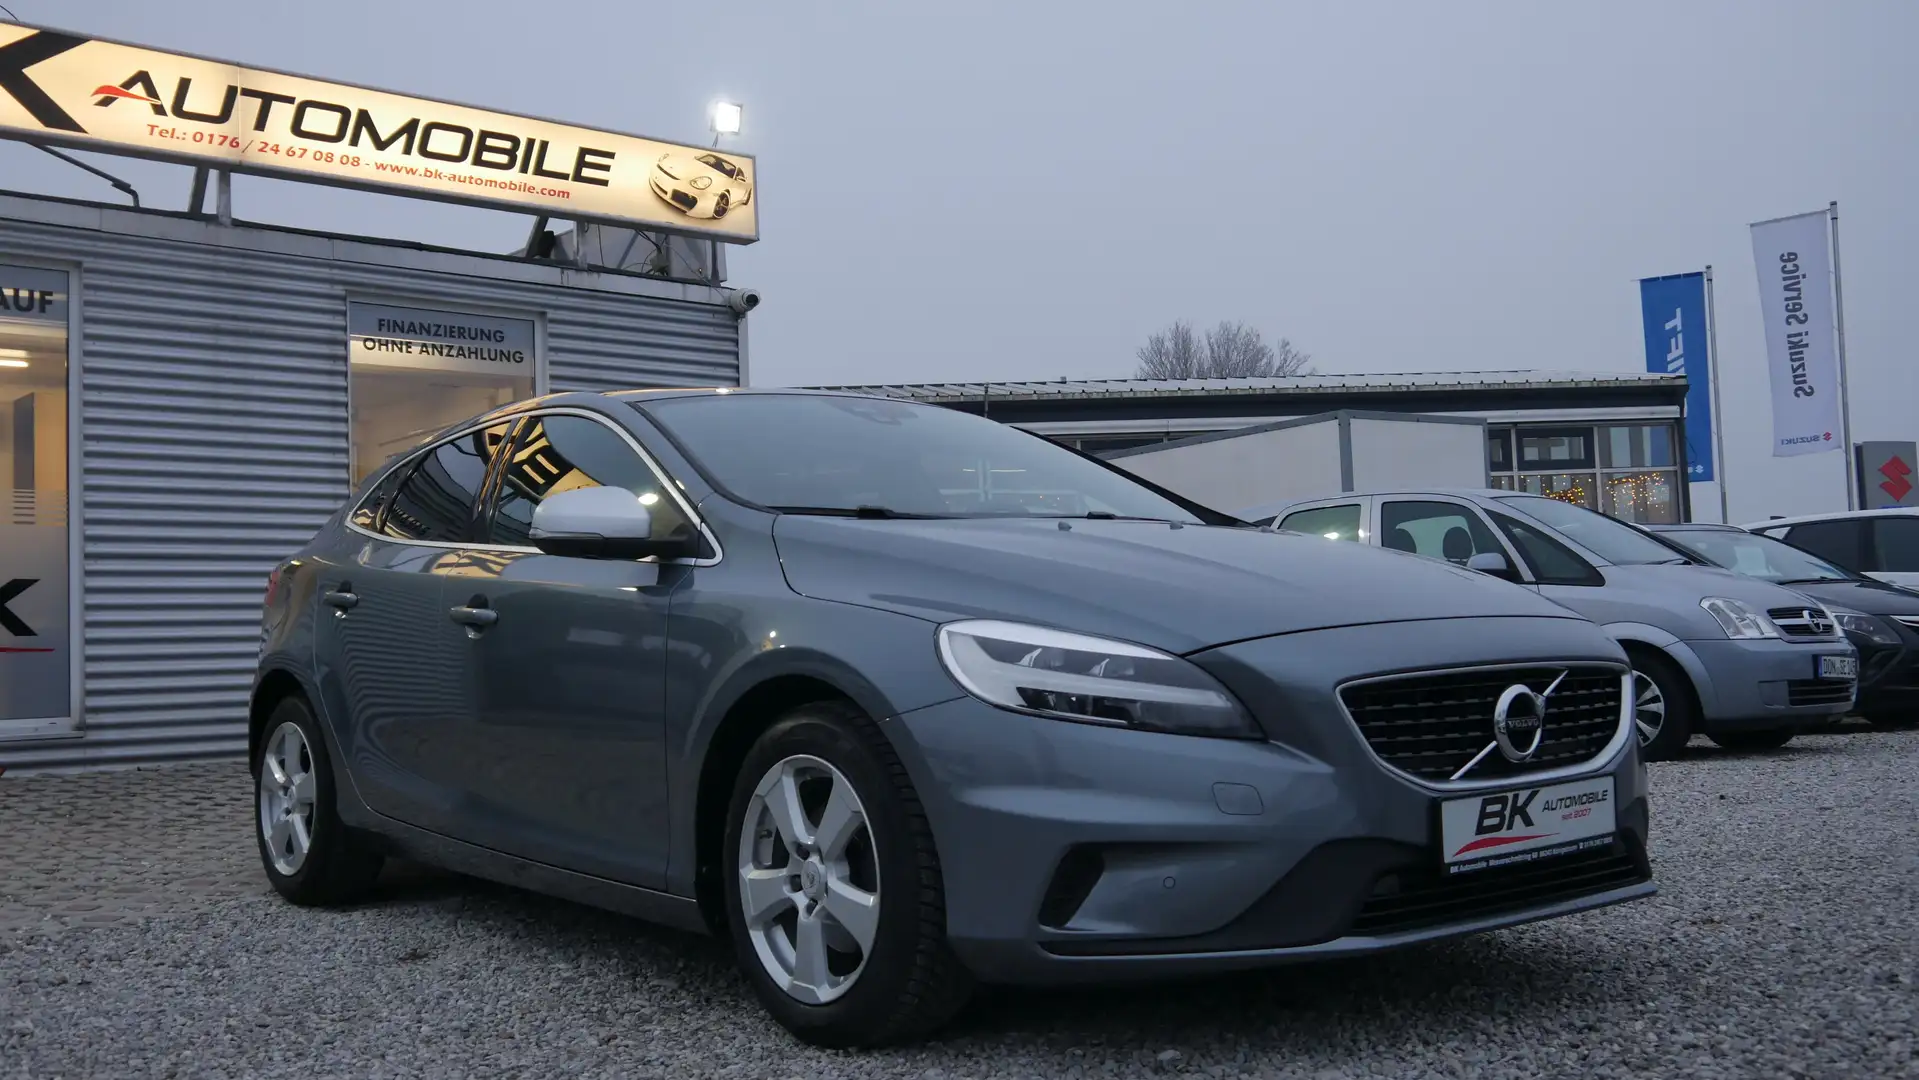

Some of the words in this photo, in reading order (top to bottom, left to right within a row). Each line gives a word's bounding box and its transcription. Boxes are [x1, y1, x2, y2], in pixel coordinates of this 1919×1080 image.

[92, 70, 616, 187] AUTOMOBILE
[147, 123, 187, 141] Tel.:
[192, 131, 240, 149] 0176
[257, 141, 281, 155] 24
[286, 144, 308, 159] 67
[313, 149, 334, 163] 08
[340, 154, 361, 167] 08
[374, 159, 571, 199] www.bk-automobile.com
[377, 318, 505, 343] FINANZIERUNG
[363, 338, 412, 354] OHNE
[419, 342, 524, 364] ANZAHLUNG
[1474, 789, 1540, 836] BK
[1541, 789, 1608, 812] AUTOMOBILE
